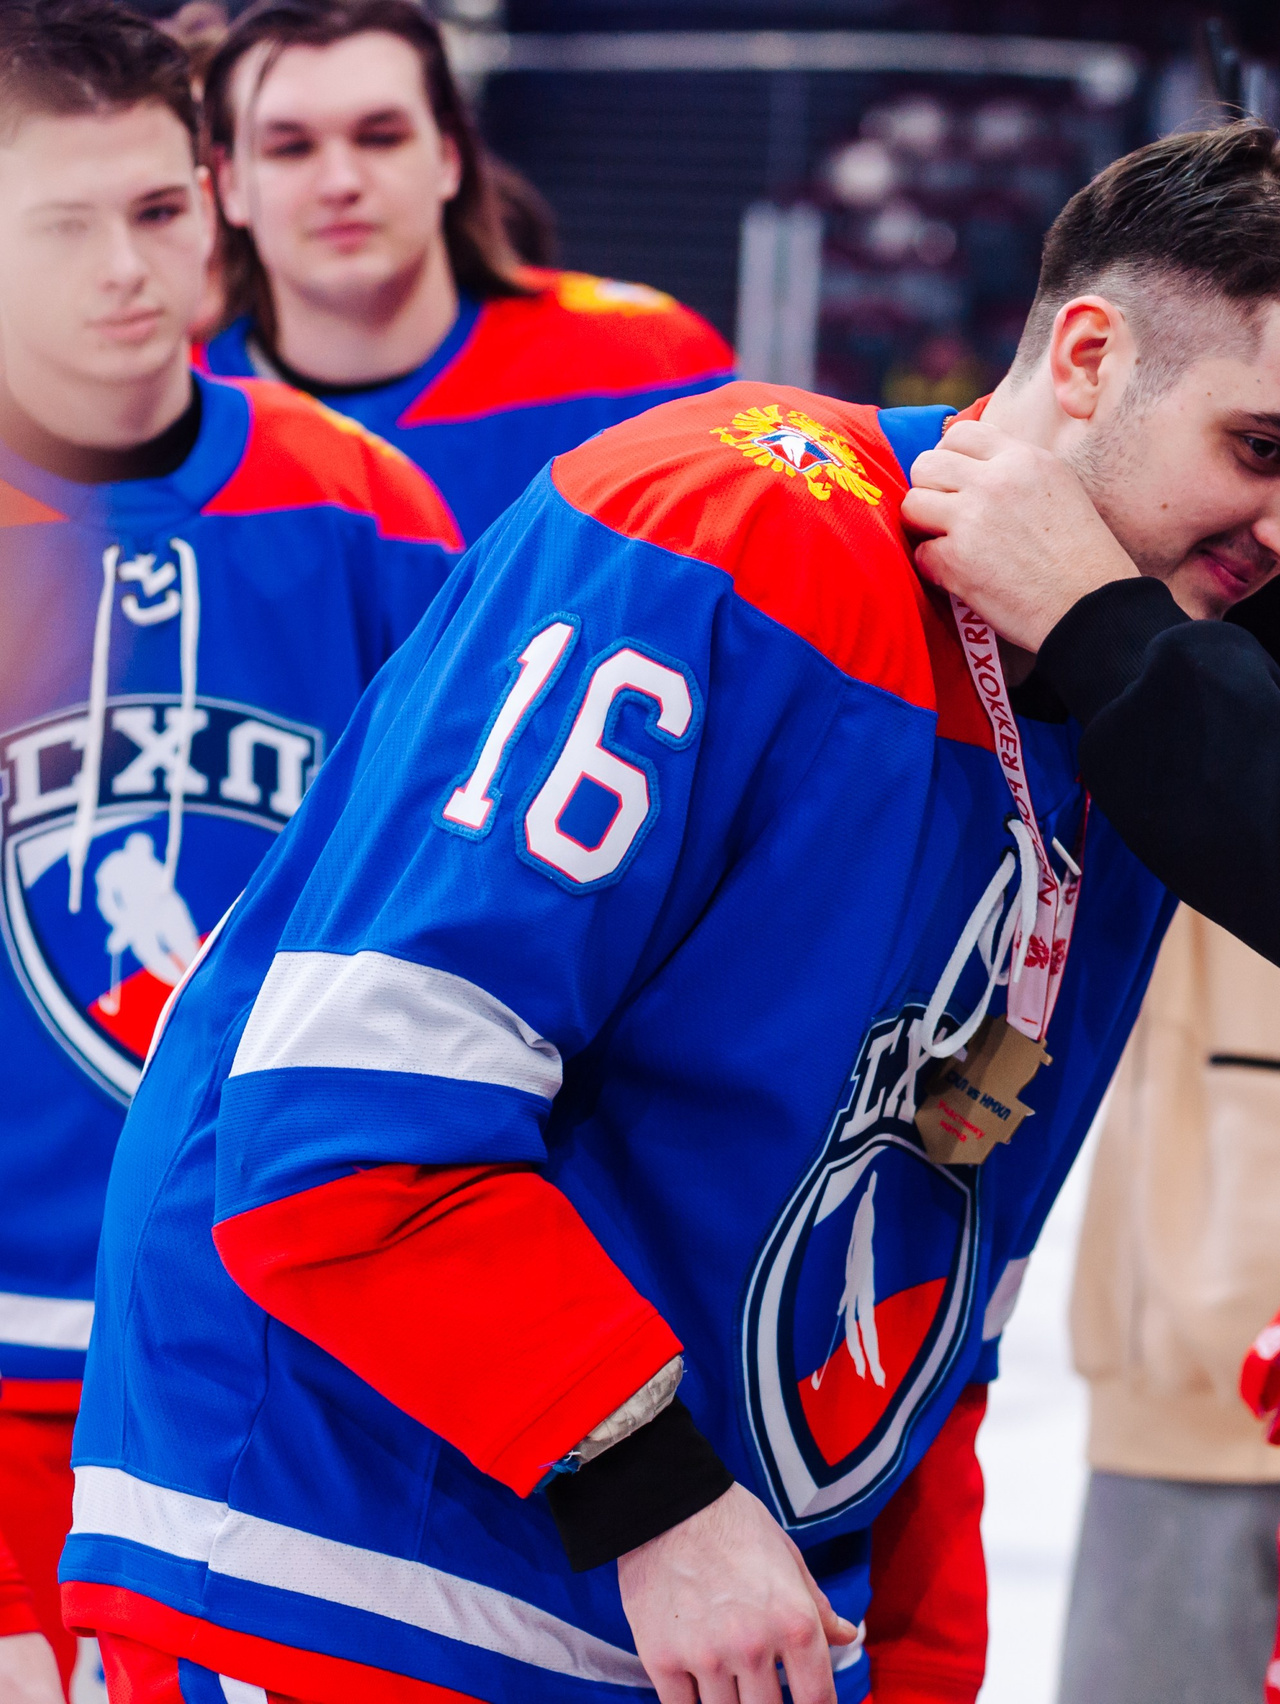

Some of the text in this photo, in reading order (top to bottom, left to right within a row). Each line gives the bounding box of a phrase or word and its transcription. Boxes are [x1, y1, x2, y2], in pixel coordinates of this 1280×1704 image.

[7, 706, 312, 826] СХЛ
[441, 621, 694, 885] 16
[838, 1018, 968, 1143] СХ
